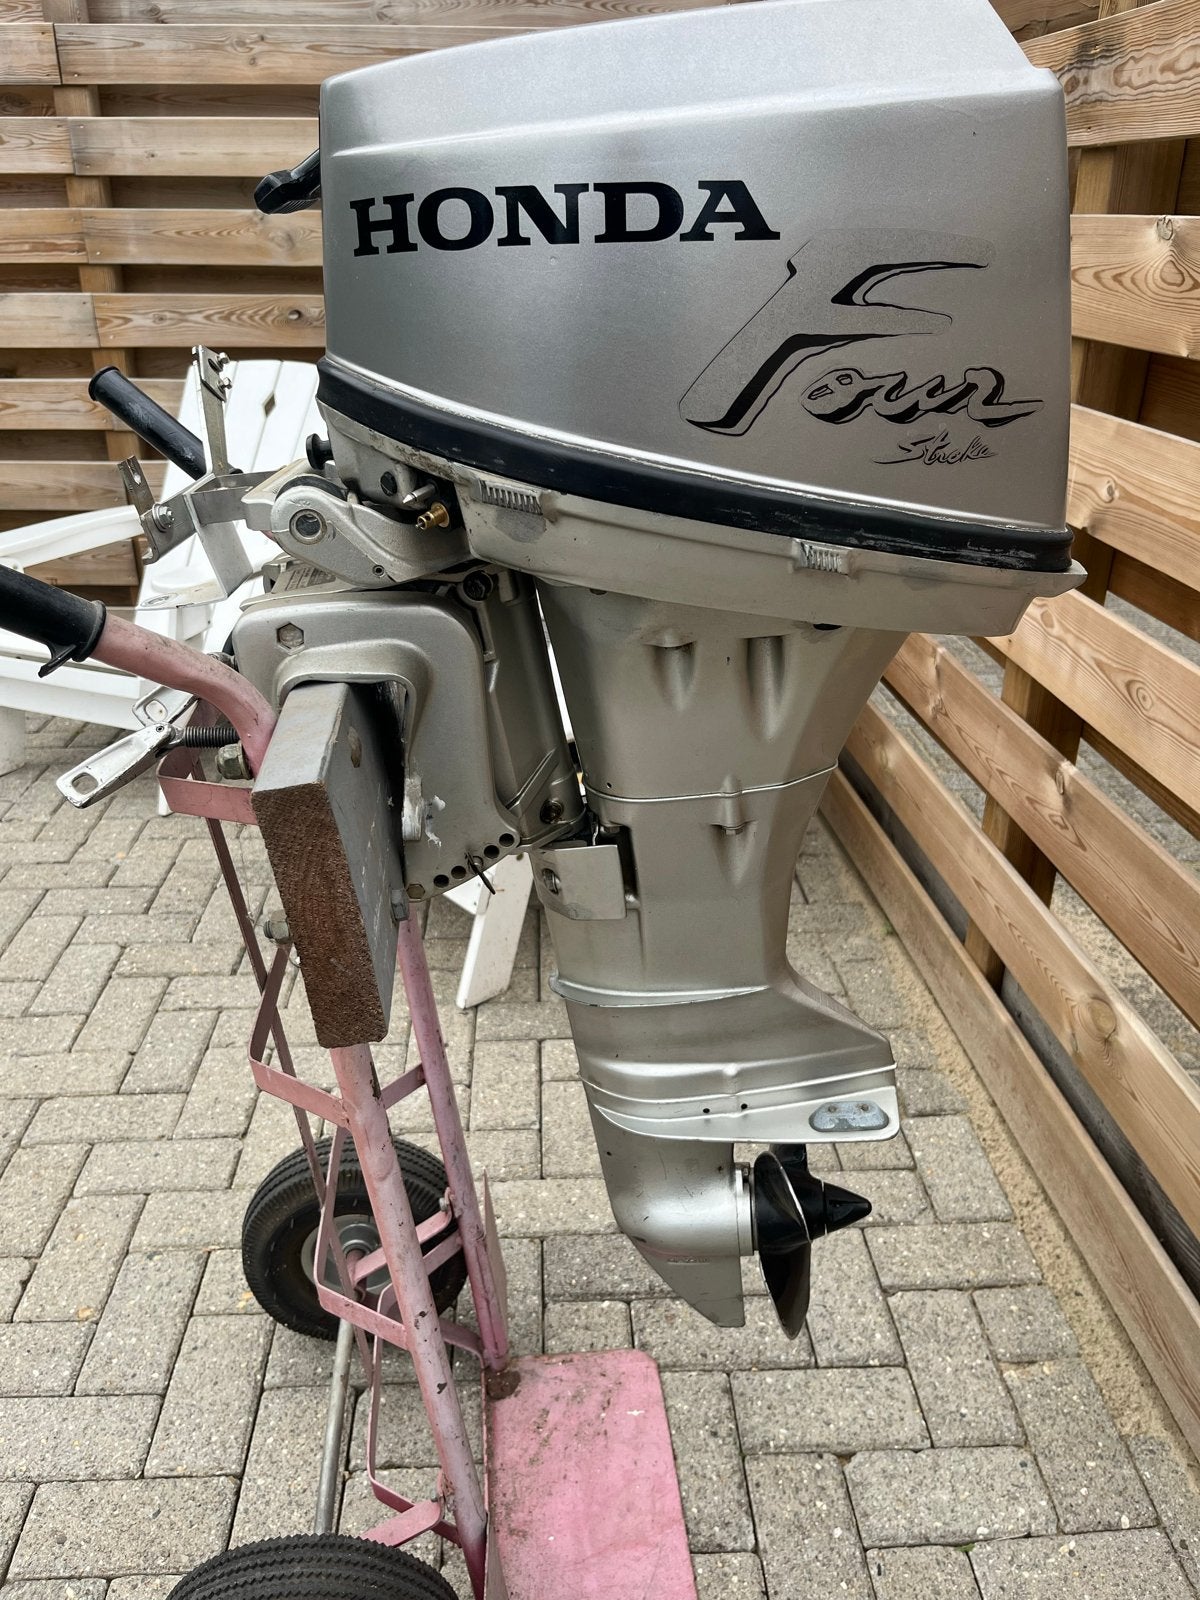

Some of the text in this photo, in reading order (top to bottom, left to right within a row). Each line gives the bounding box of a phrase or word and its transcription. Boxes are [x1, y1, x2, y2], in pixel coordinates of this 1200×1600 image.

[349, 180, 781, 257] HONDA
[678, 228, 1044, 436] Four
[872, 429, 999, 466] Stroke
